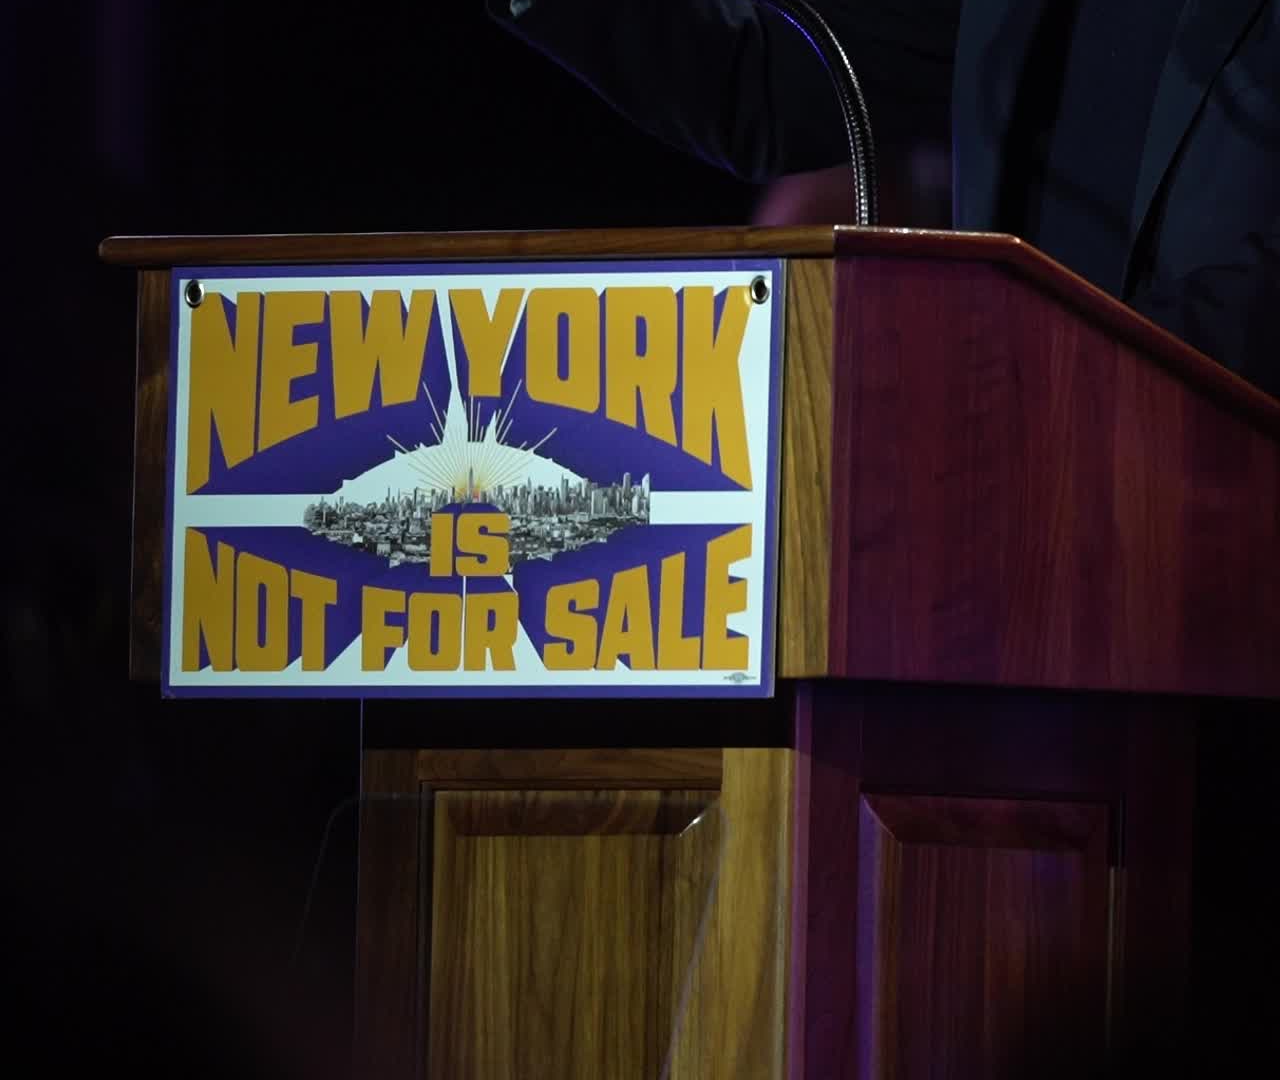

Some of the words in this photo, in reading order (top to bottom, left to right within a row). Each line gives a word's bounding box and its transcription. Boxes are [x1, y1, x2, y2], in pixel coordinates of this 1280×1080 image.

[186, 289, 435, 495] NEW
[448, 285, 753, 491] YORK
[181, 526, 338, 672] NOT
[361, 585, 520, 672] FOR
[542, 523, 753, 672] SALE
[429, 512, 512, 577] IS
